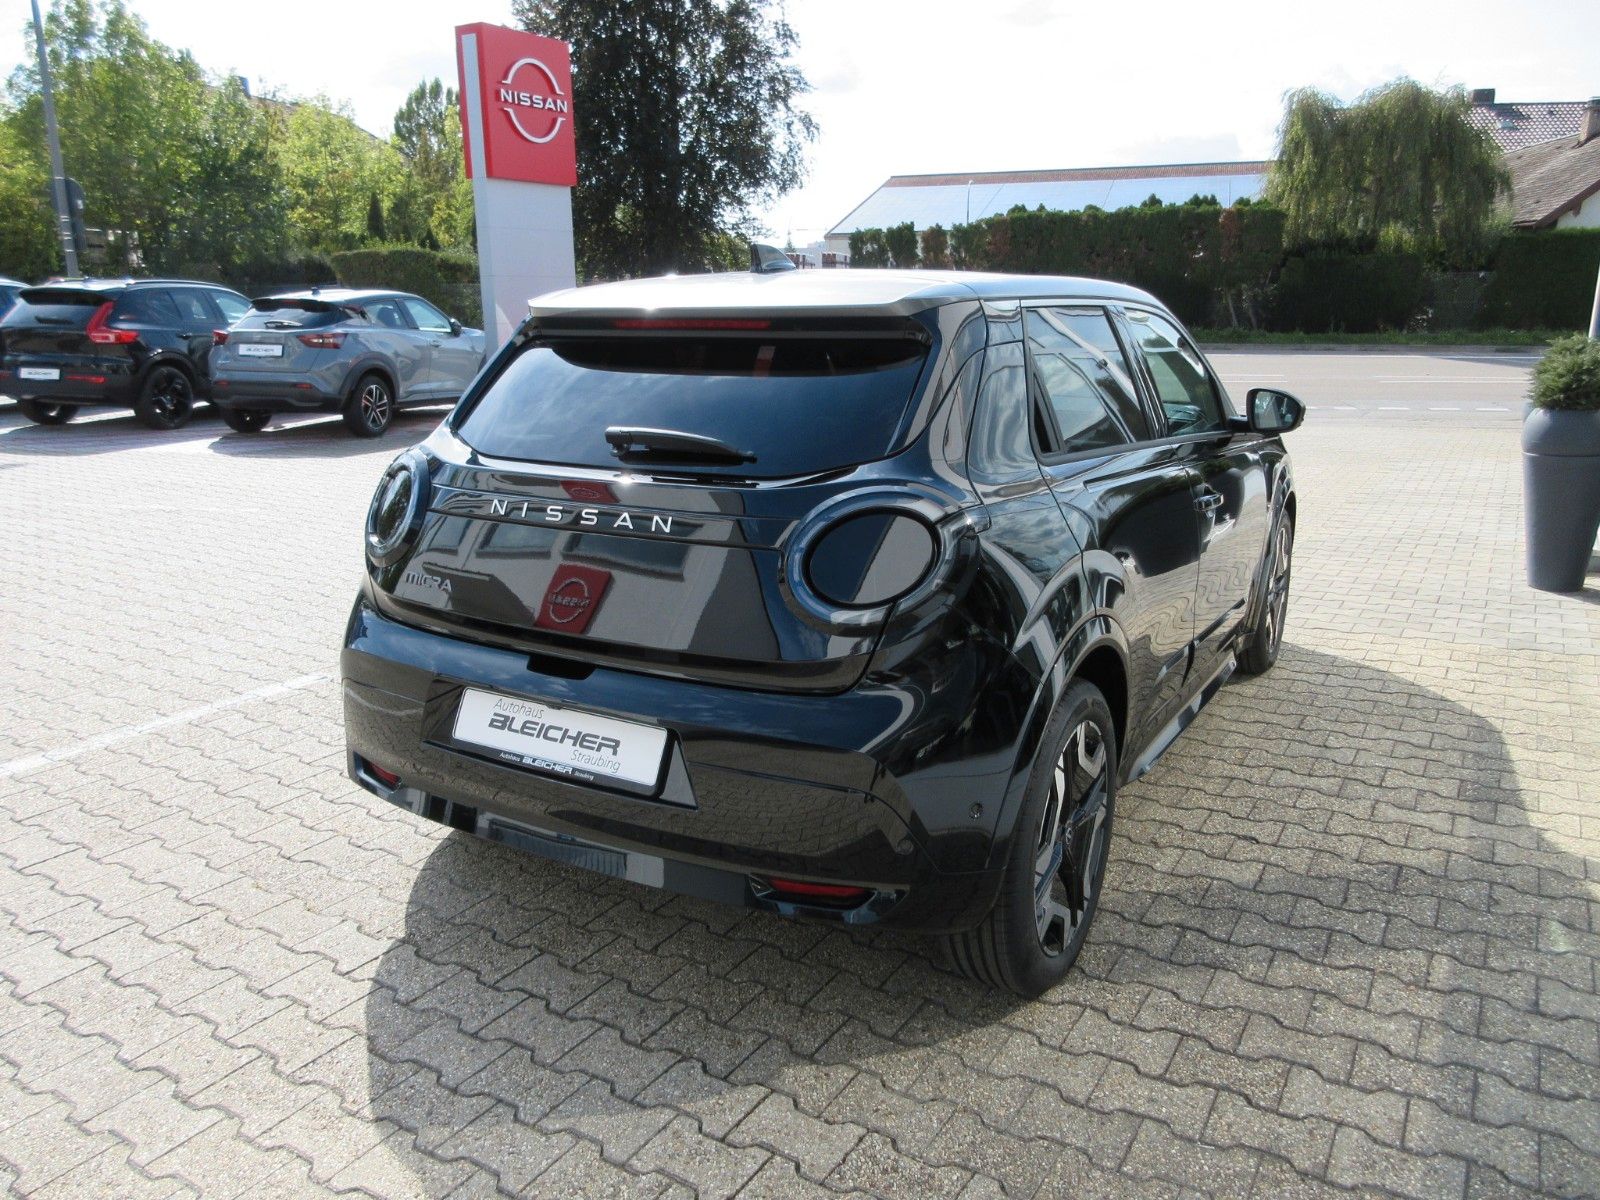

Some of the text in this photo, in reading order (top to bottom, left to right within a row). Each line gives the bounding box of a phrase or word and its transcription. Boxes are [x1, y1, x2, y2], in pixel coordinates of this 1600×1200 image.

[500, 88, 568, 113] NISSAN
[490, 499, 673, 533] NISSAN
[494, 699, 545, 719] Autohaus
[488, 712, 621, 756] BLEICHER
[522, 756, 573, 774] BLEICHER
[570, 749, 621, 774] Straubing
